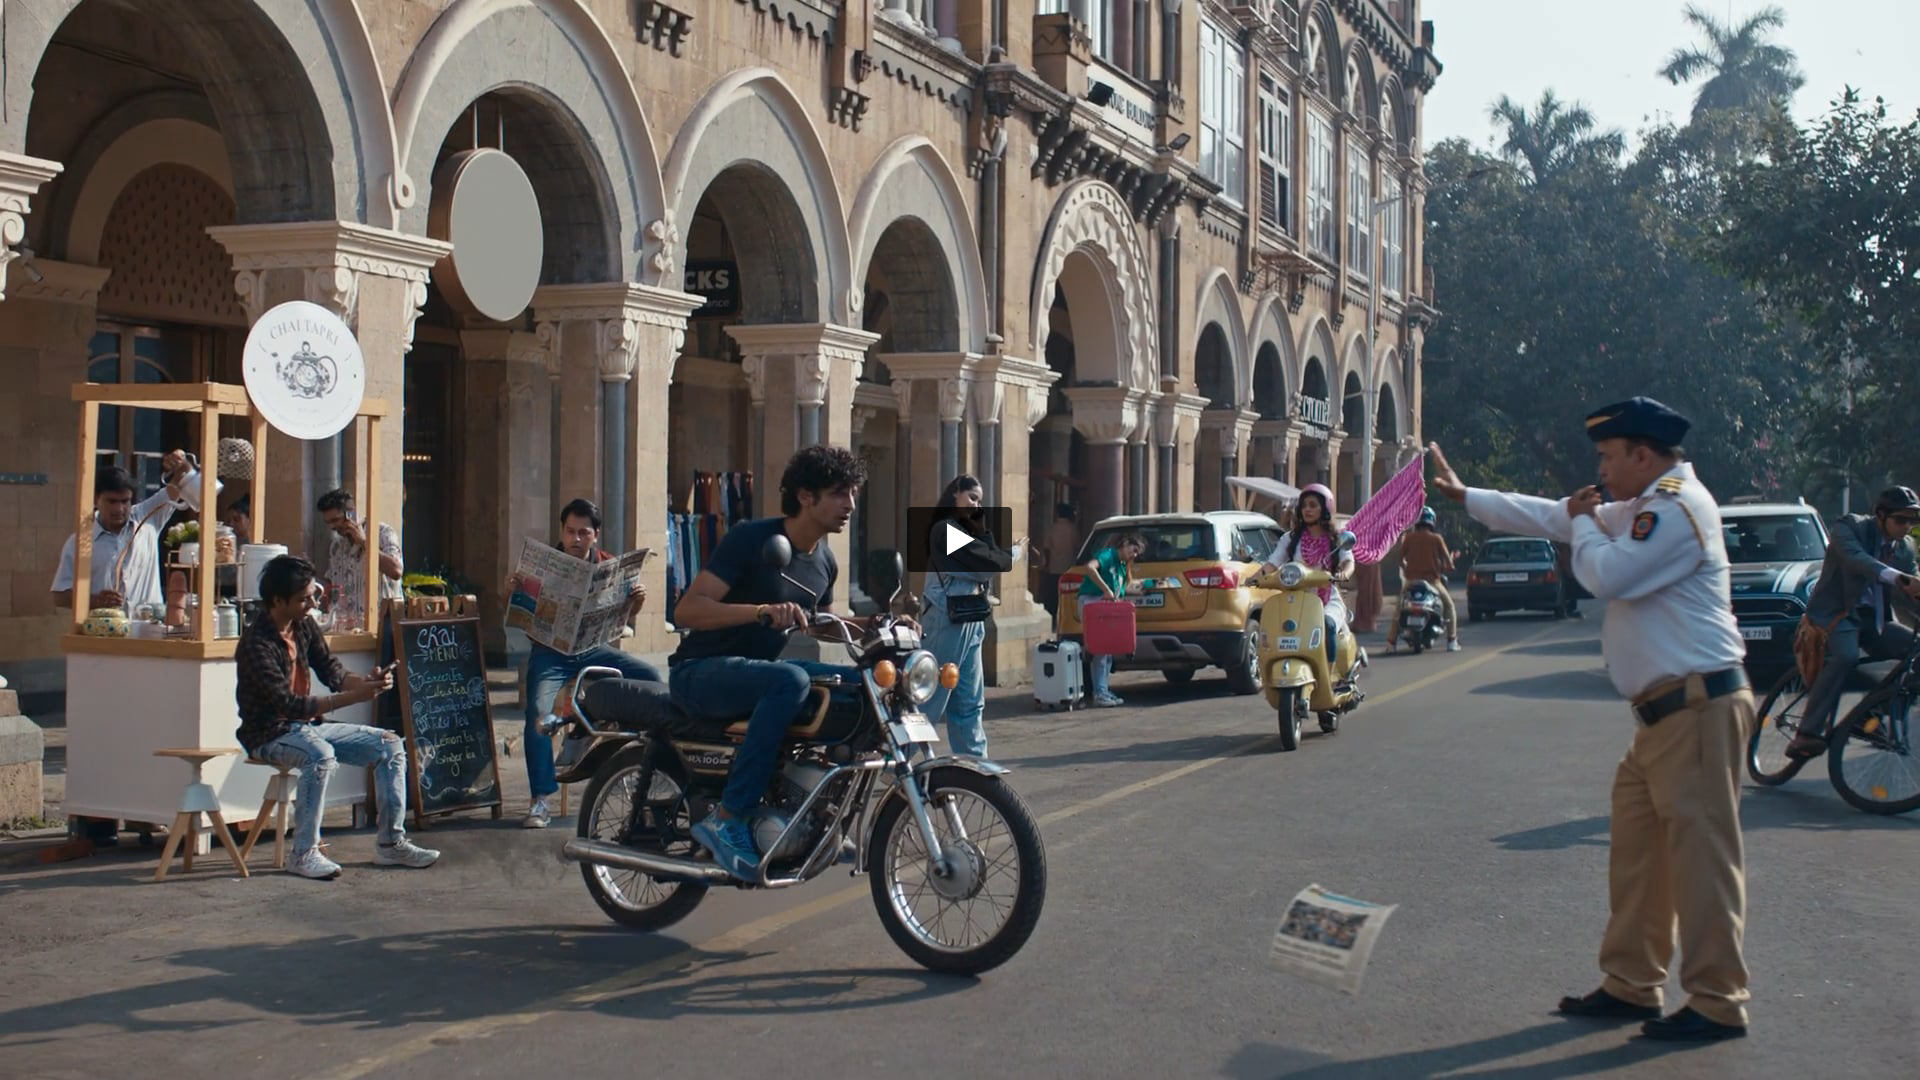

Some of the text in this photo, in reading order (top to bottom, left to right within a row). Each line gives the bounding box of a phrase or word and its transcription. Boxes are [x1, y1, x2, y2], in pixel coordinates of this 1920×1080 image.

[270, 319, 340, 346] CHAI TAPRI
[429, 647, 459, 662] MENU
